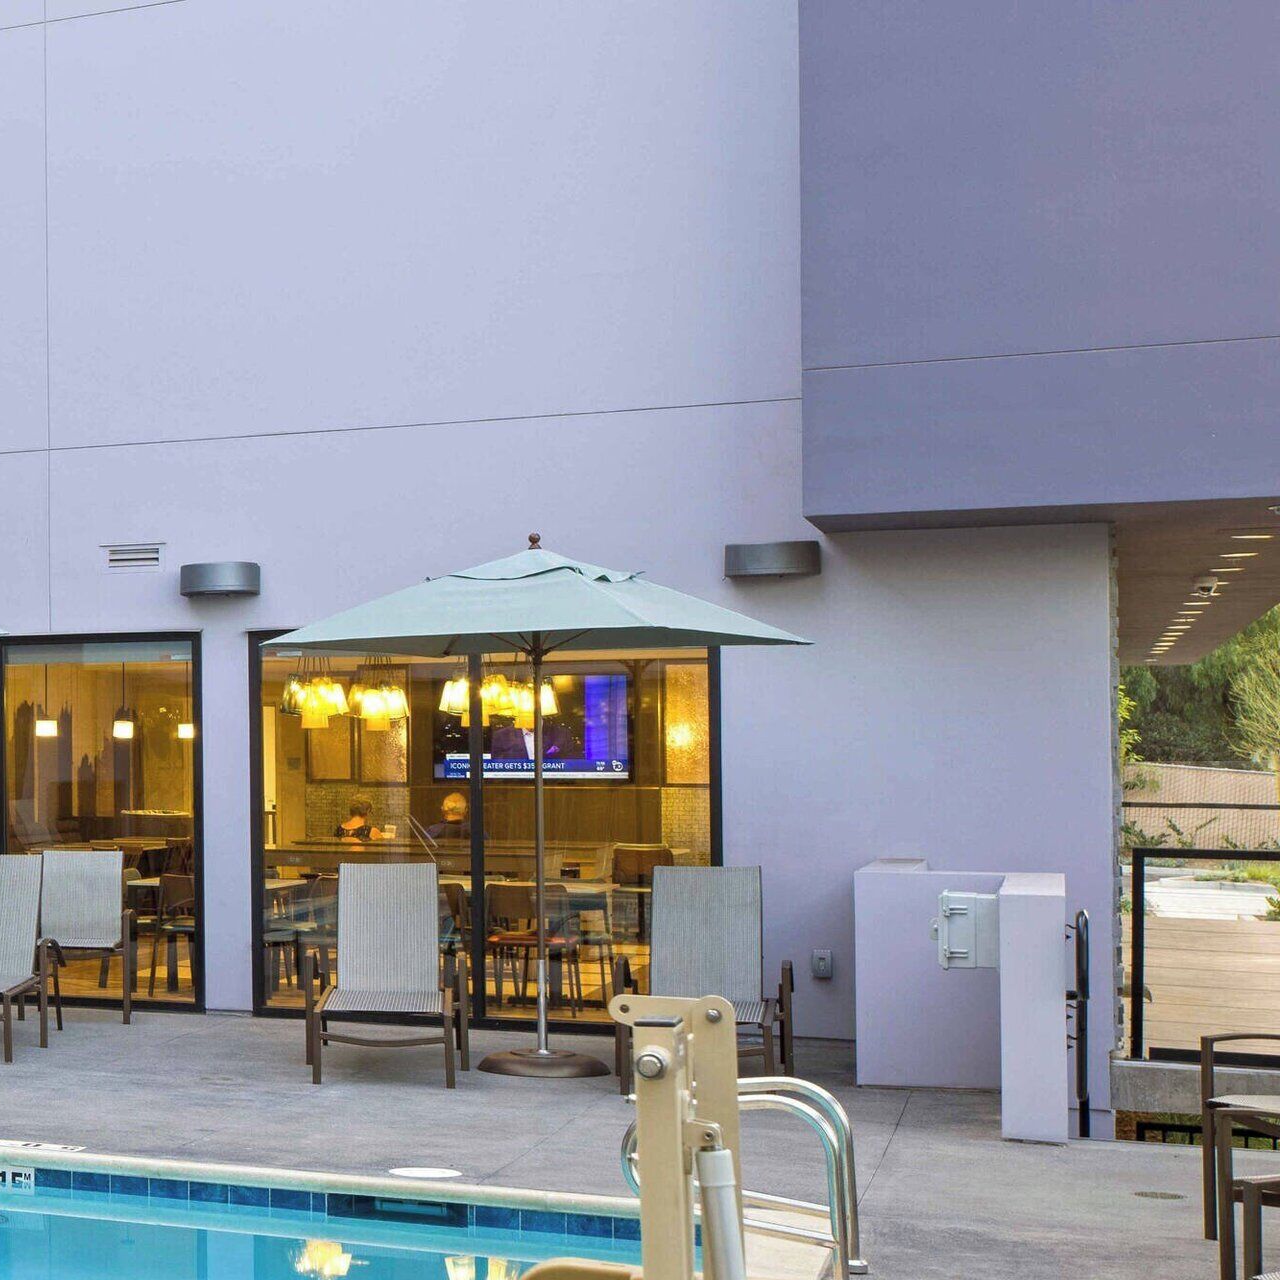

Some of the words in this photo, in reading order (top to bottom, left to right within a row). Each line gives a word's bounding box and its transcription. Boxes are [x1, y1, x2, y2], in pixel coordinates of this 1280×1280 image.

[483, 762, 503, 770] EATER
[504, 762, 522, 770] GETS
[523, 762, 535, 770] $35
[542, 762, 565, 770] GRANT
